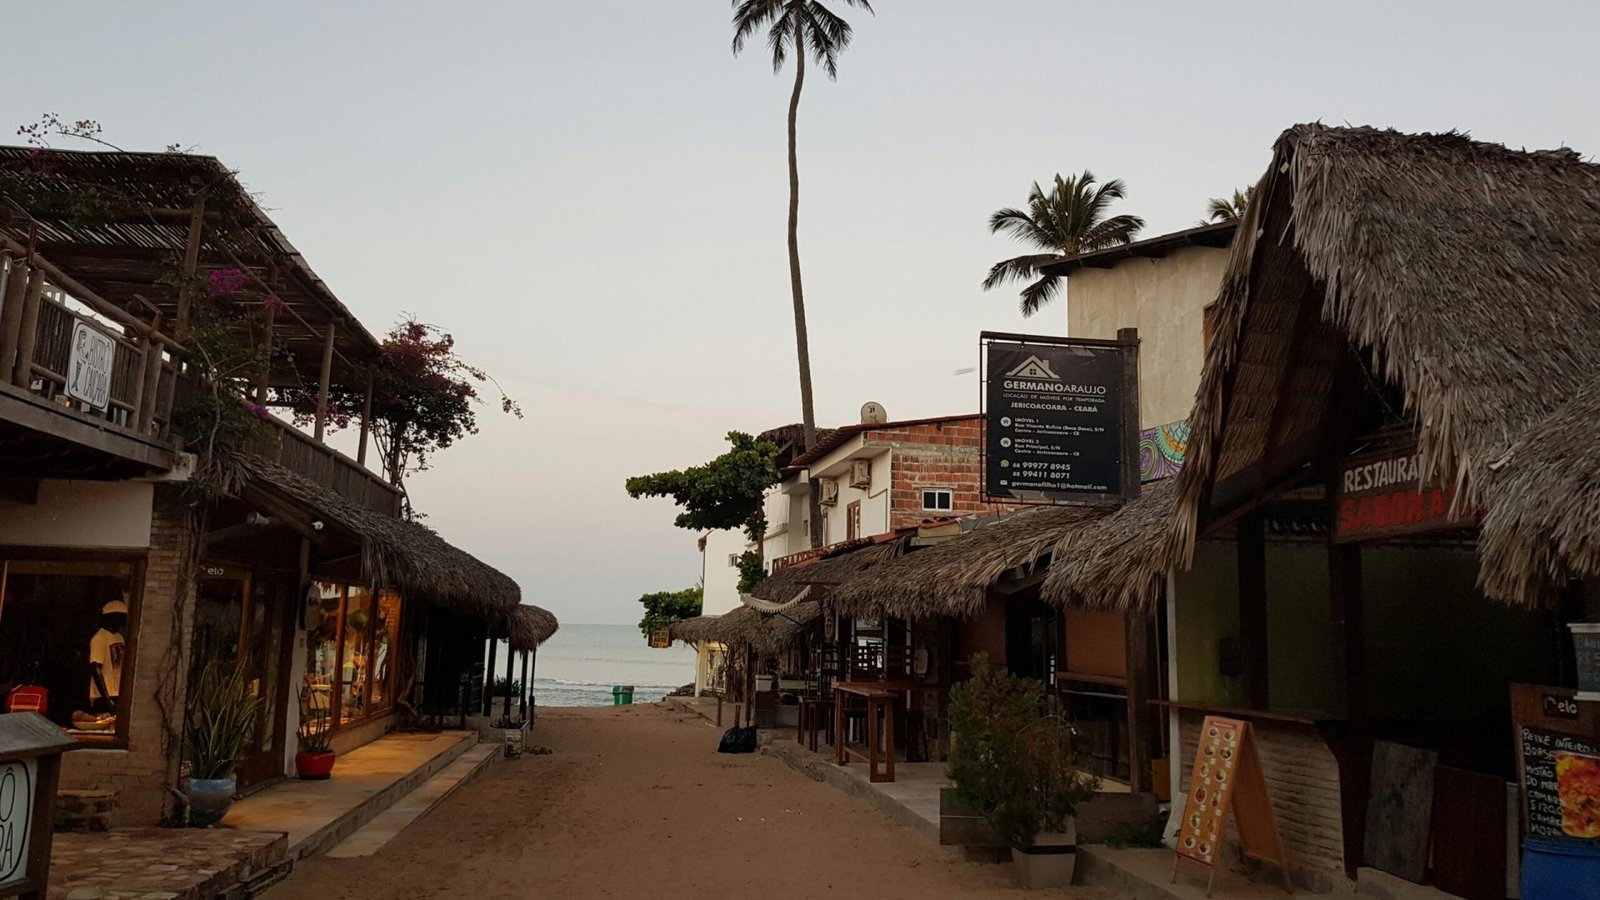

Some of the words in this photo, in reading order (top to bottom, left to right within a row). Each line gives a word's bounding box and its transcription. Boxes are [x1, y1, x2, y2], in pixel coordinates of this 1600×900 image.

[1004, 380, 1106, 394] GERMANOARAUJO
[1011, 402, 1067, 411] JERICOACOARA
[1522, 727, 1552, 746] PEIXE
